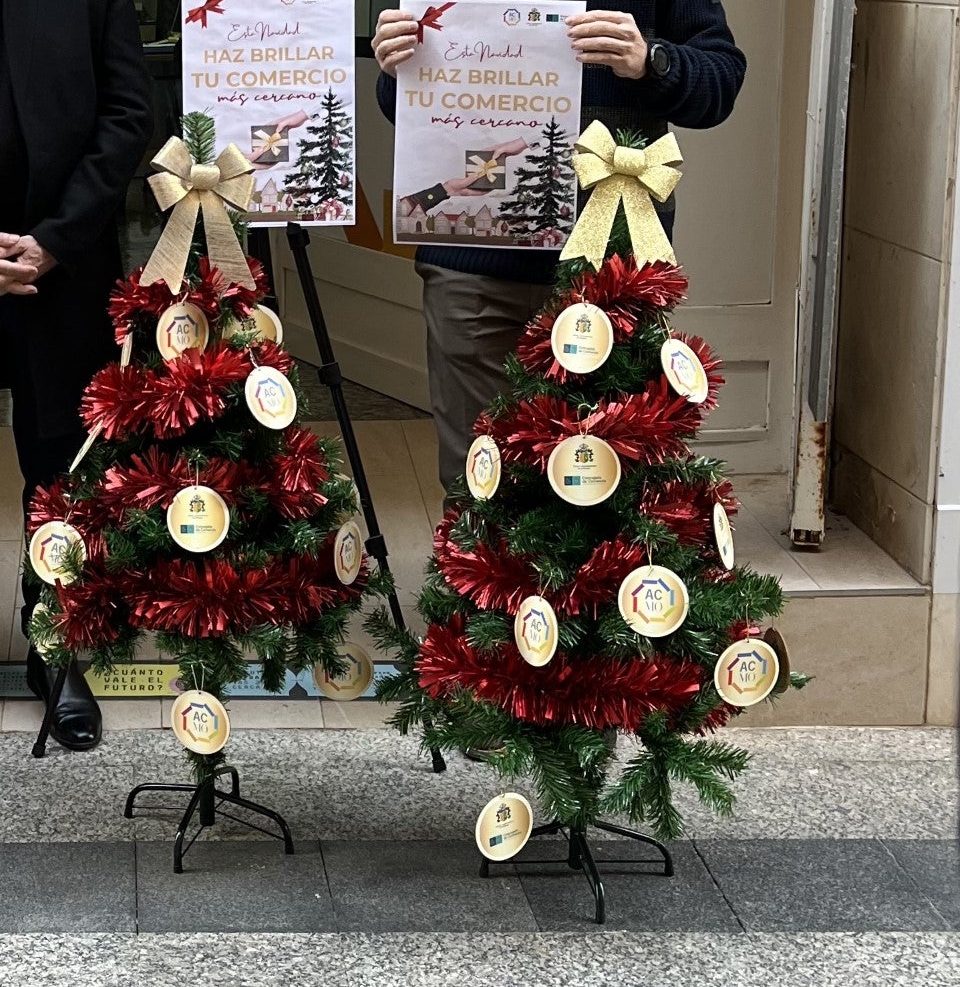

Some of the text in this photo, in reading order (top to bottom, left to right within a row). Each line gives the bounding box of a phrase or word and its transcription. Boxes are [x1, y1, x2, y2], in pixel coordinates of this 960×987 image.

[227, 23, 255, 42] Esta
[203, 46, 334, 63] HAZ BRILLAR
[444, 41, 473, 61] Esta
[191, 68, 347, 88] TU COMERCIO
[418, 67, 559, 87] HAZ BRILLAR
[217, 90, 321, 106] más cercano
[405, 90, 572, 113] TU COMERCIO
[431, 113, 542, 129] más cercano
[175, 324, 189, 334] AC
[263, 386, 276, 397] AC
[479, 457, 489, 470] AC
[644, 589, 661, 600] AC
[644, 601, 662, 612] MO
[530, 618, 541, 632] AC
[738, 661, 755, 672] AC
[738, 672, 755, 683] MO
[192, 711, 207, 722] AC
